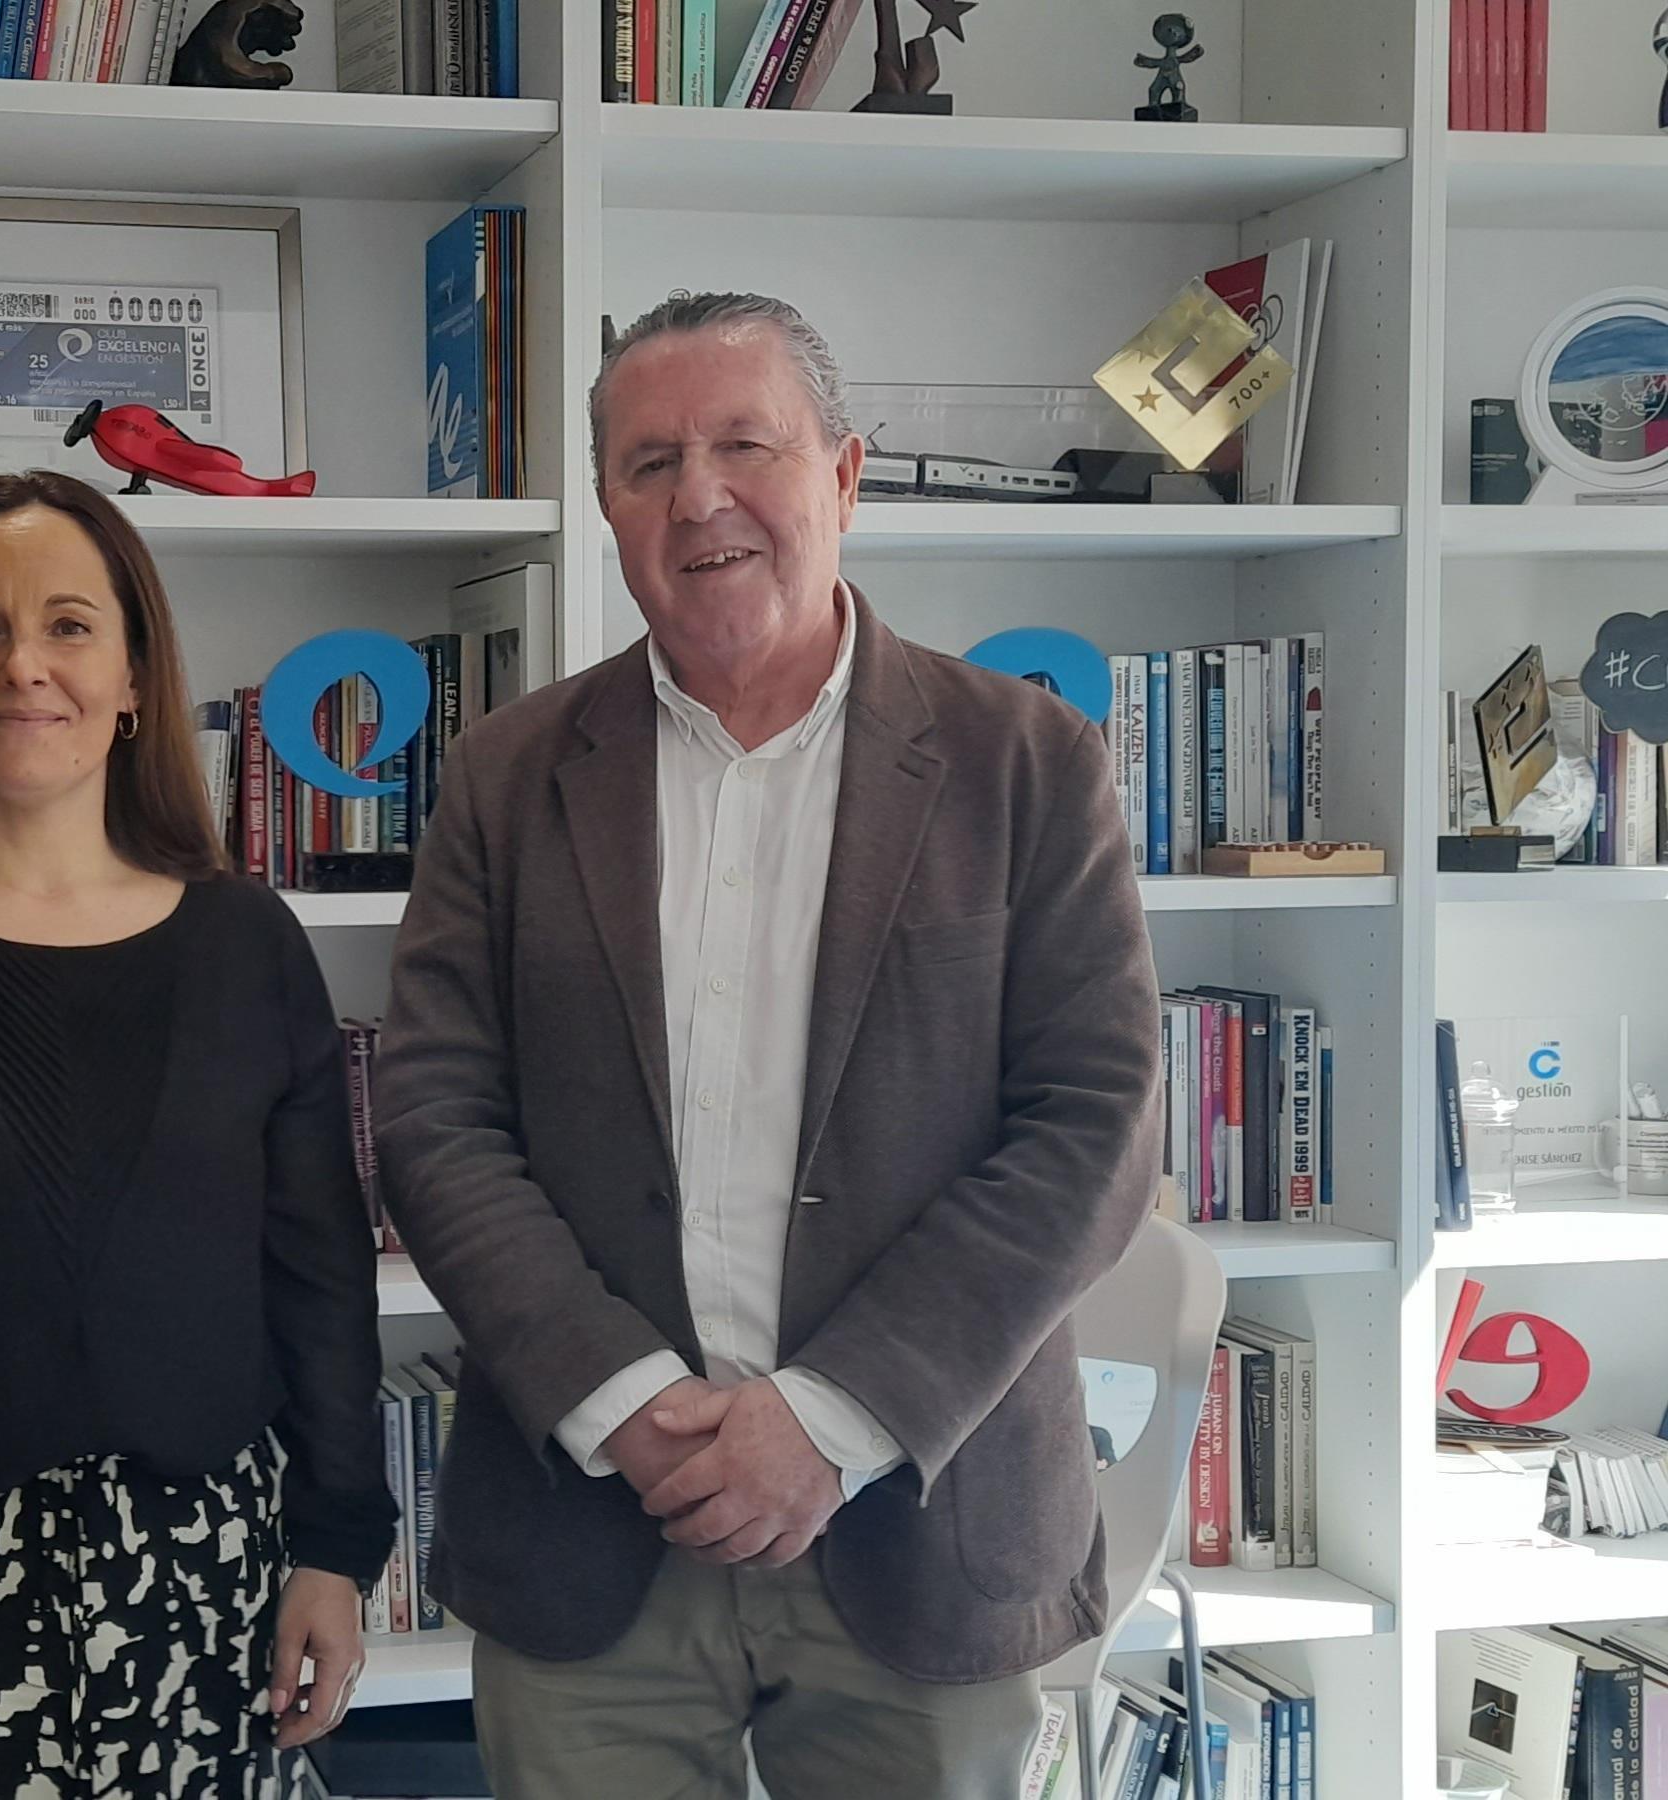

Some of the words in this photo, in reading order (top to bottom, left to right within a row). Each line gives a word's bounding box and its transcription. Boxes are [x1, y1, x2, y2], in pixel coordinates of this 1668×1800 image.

[25, 18, 36, 35] del
[19, 37, 34, 73] Cliente
[785, 46, 808, 83] COSTE
[802, 35, 813, 46] &
[74, 308, 97, 321] 000
[97, 329, 126, 340] CLUB
[97, 339, 181, 354] EXCELENCIA
[29, 354, 49, 369] 25
[97, 353, 115, 363] EN
[191, 331, 207, 387] ONCE
[1228, 370, 1271, 410] 700+
[444, 682, 457, 718] LEAN
[250, 731, 263, 762] PODER
[1131, 703, 1144, 764] KAIZEN
[1314, 718, 1323, 744] WHY
[250, 764, 263, 776] DE
[1314, 748, 1323, 794] PEOPLE
[250, 777, 263, 798] SEIS
[250, 800, 264, 832] SIGMA
[1212, 1036, 1224, 1055] the
[1294, 1014, 1311, 1061] KNOCK
[1212, 1056, 1223, 1093] Clouds
[1294, 1066, 1311, 1092] 'EM
[1294, 1096, 1311, 1136] DEAD
[1294, 1140, 1311, 1173] 1999
[1541, 1152, 1582, 1165] SÁNCHEZ
[1280, 1371, 1290, 1421] CALIDAD
[1300, 1370, 1311, 1421] CALIDAD
[1210, 1391, 1223, 1433] JURAN
[1199, 1446, 1211, 1461] BY
[1211, 1436, 1223, 1455] ON
[1199, 1463, 1211, 1508] DESIGN
[415, 1490, 436, 1539] Loyalty
[1038, 1712, 1062, 1750] TEAM
[1628, 1685, 1640, 1752] Calidad
[1611, 1727, 1624, 1750] de
[1629, 1758, 1640, 1775] la
[1630, 1780, 1640, 1800] de
